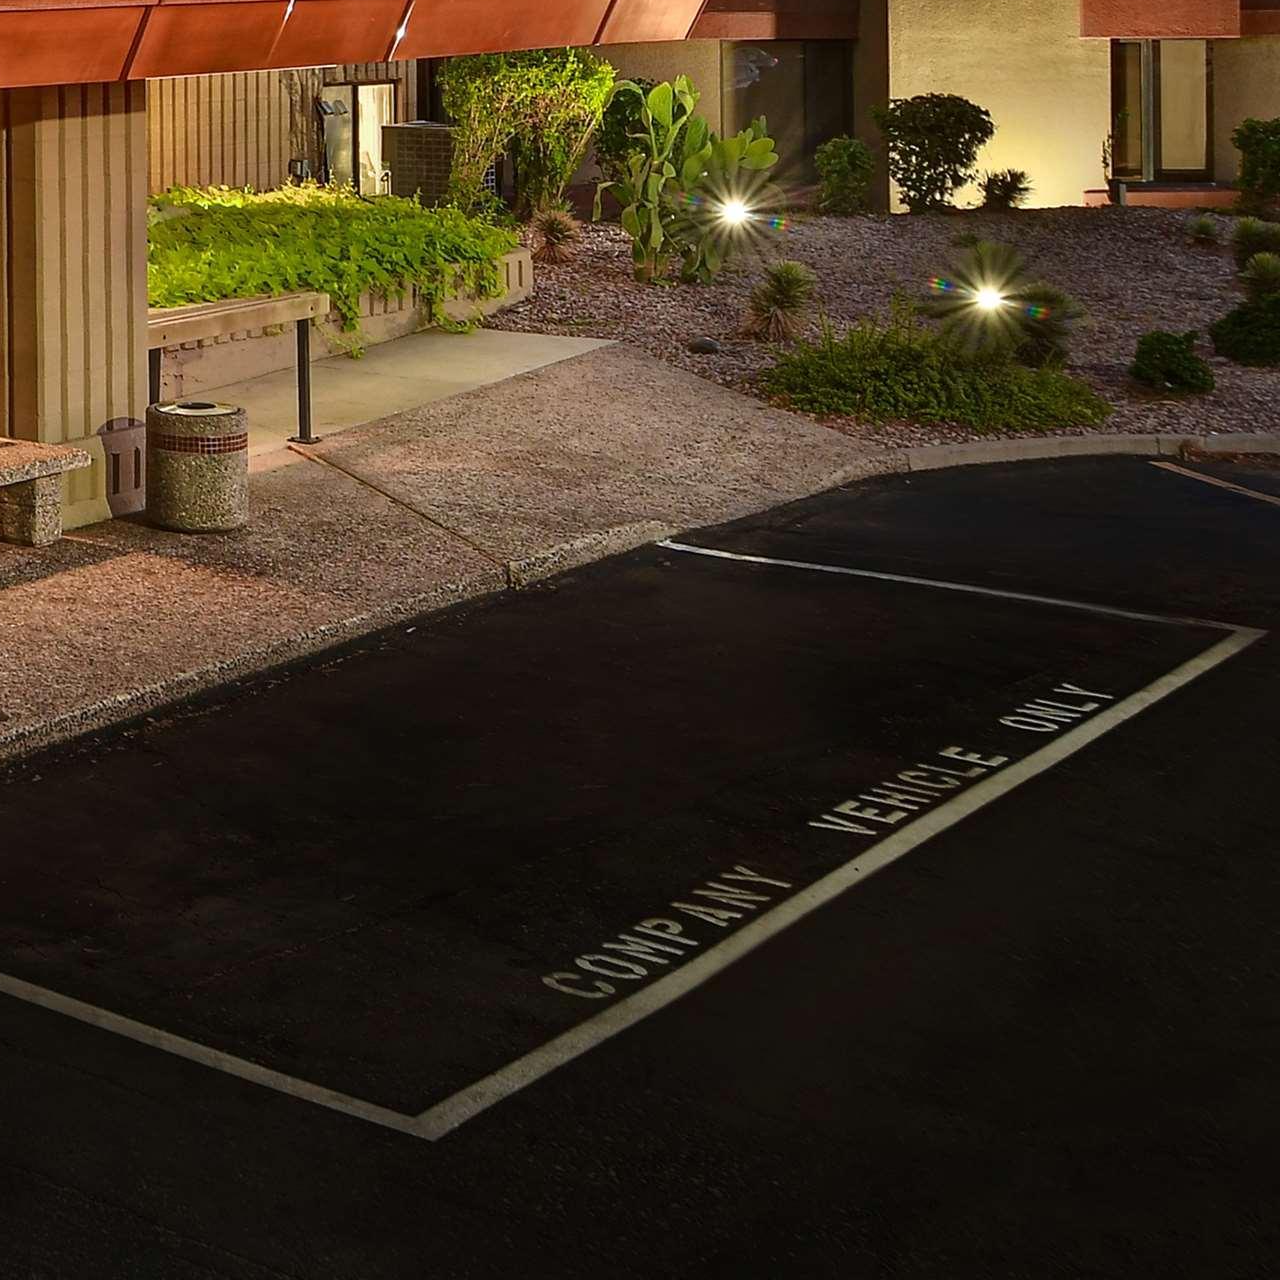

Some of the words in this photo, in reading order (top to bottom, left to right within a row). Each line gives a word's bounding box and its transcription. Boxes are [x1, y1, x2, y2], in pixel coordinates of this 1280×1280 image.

[541, 864, 792, 999] COMPANY
[807, 745, 1009, 836] VEHICLE
[998, 682, 1114, 733] ONLY
